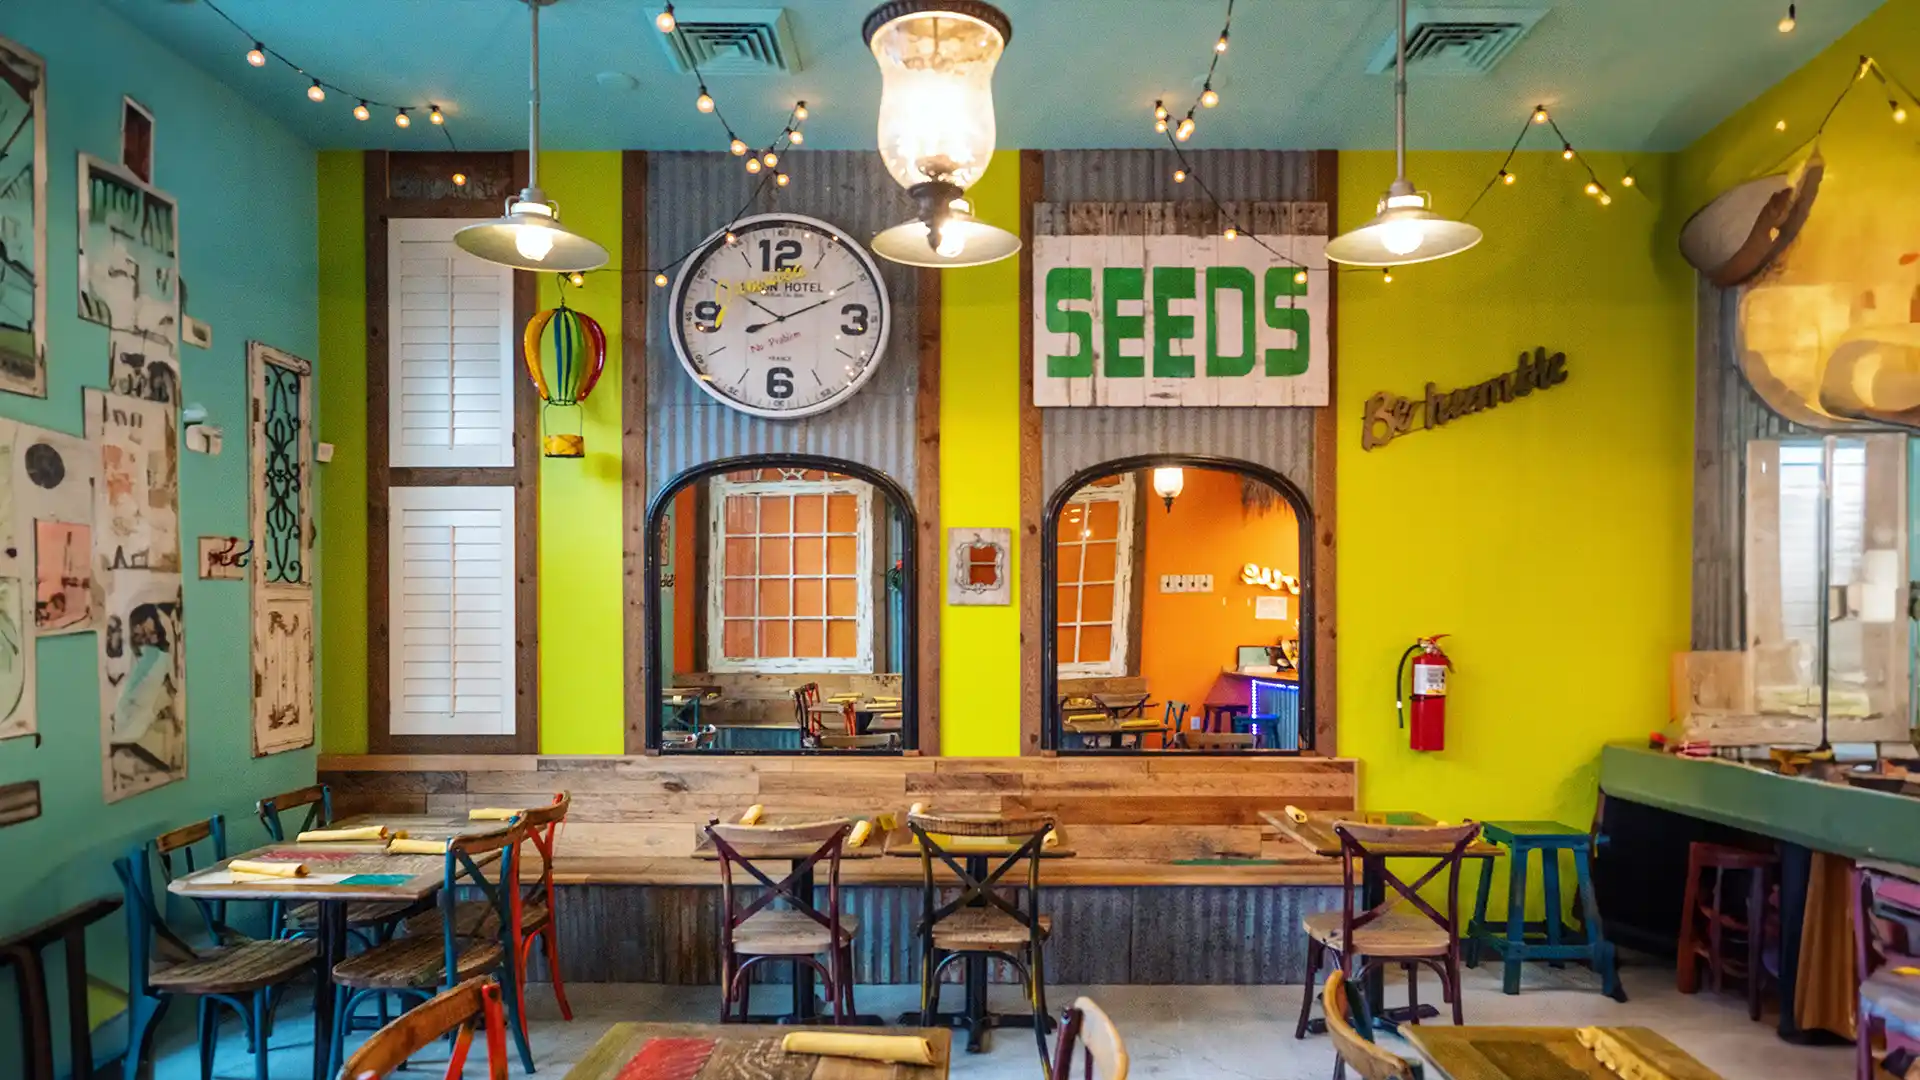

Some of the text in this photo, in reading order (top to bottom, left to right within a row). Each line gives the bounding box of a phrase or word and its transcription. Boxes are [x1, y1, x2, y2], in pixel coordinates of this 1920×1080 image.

[759, 239, 803, 273] 12
[785, 281, 824, 293] HOTEL
[694, 301, 723, 333] 9
[840, 303, 869, 336] 3
[1045, 266, 1311, 378] SEEDS
[766, 366, 794, 399] 6
